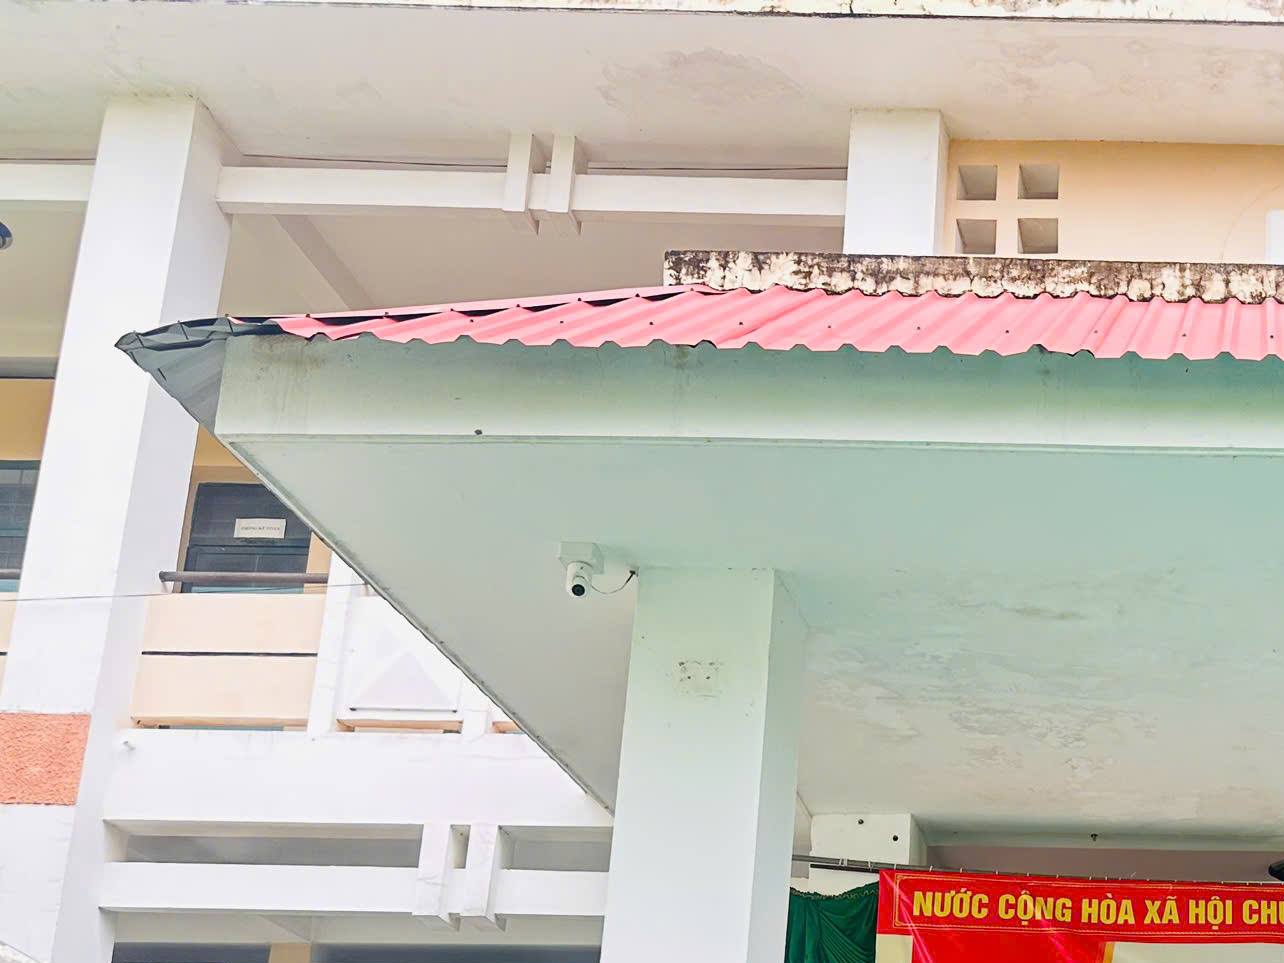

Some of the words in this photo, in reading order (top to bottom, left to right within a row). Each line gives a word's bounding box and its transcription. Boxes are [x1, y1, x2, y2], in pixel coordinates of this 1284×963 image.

[912, 888, 989, 919] NƯỚC
[998, 890, 1072, 925] CỘNG
[1081, 892, 1135, 925] HÒA
[1144, 895, 1179, 925] XÃ
[1188, 895, 1233, 930] HỘI
